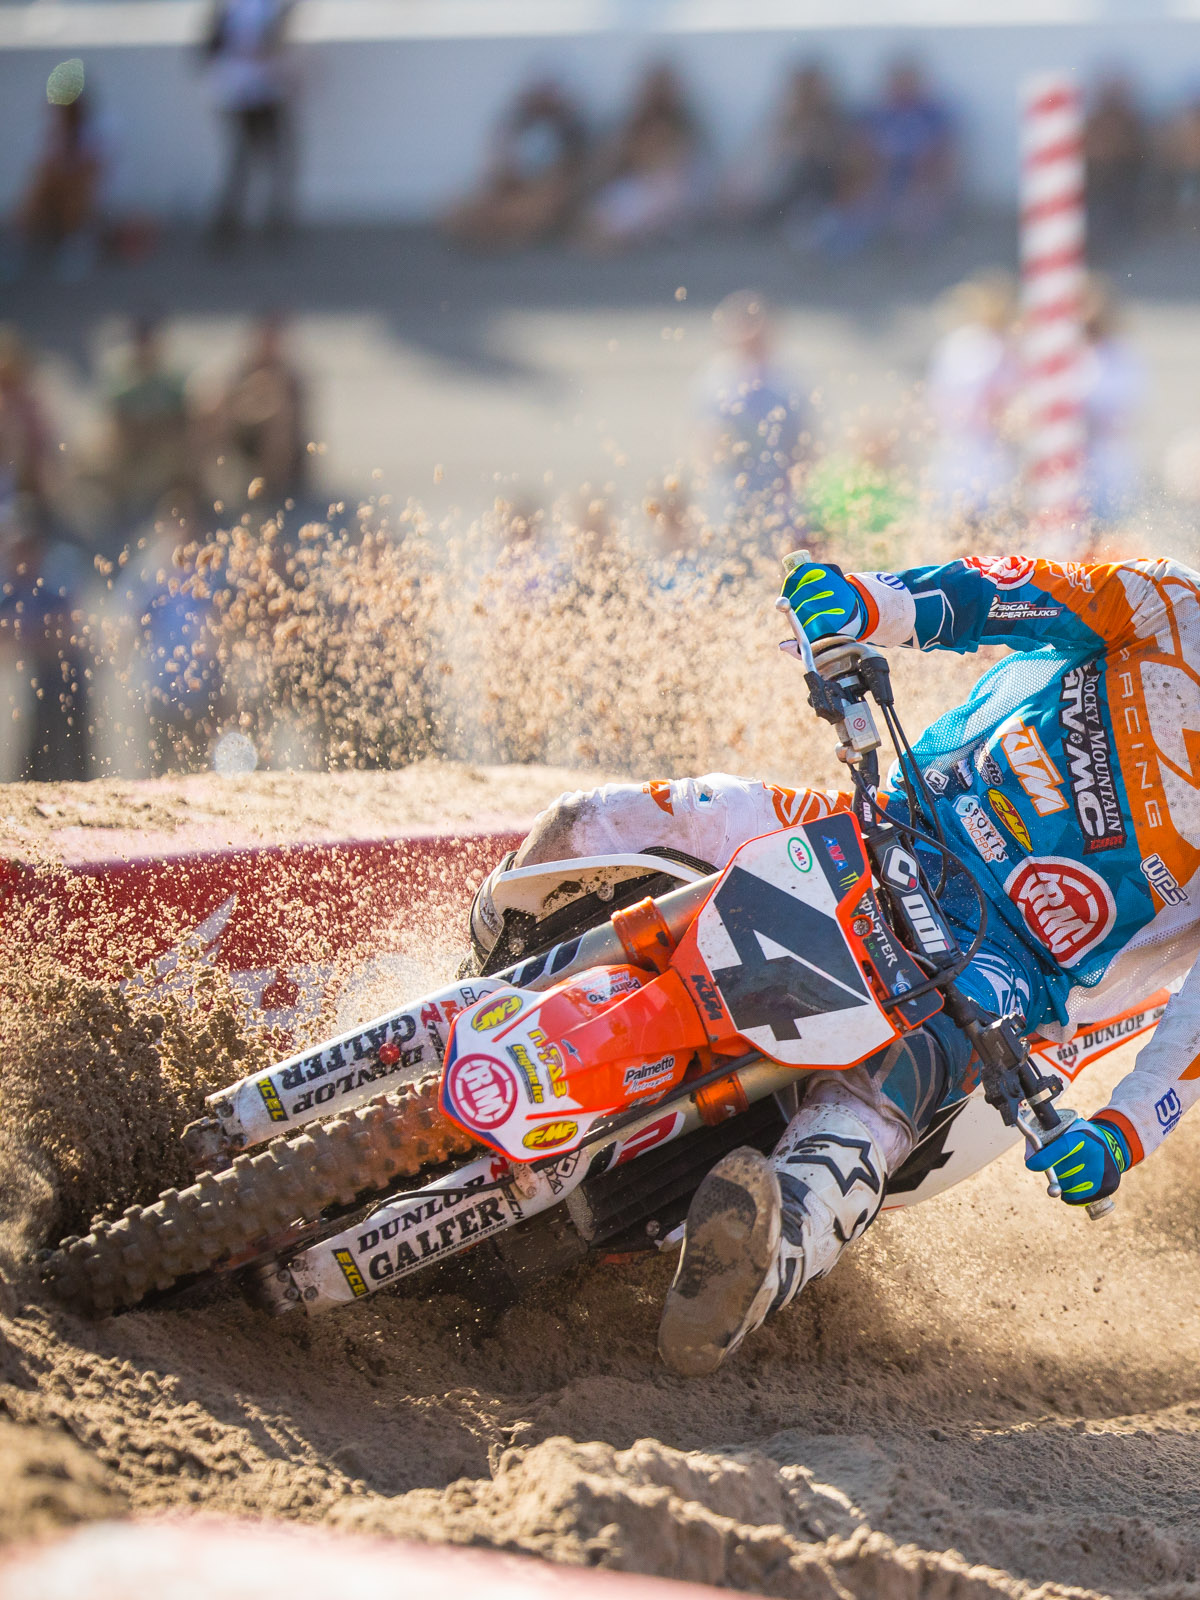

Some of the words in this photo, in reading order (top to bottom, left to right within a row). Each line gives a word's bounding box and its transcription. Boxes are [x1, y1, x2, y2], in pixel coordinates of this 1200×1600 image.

[1083, 673, 1100, 725] ROCKY
[1000, 717, 1069, 817] KTM
[1089, 729, 1122, 832] MOUNTAIN
[821, 835, 848, 872] AMA
[1140, 853, 1189, 907] WPS
[712, 865, 873, 1042] 4
[859, 893, 898, 968] ONSTER
[691, 975, 723, 1020] KTM
[1082, 1013, 1145, 1050] DUNLOP
[624, 1055, 675, 1083] Palmetto
[257, 1077, 286, 1121] XCEL
[523, 1121, 578, 1149] FMF
[369, 1195, 506, 1281] GALFER
